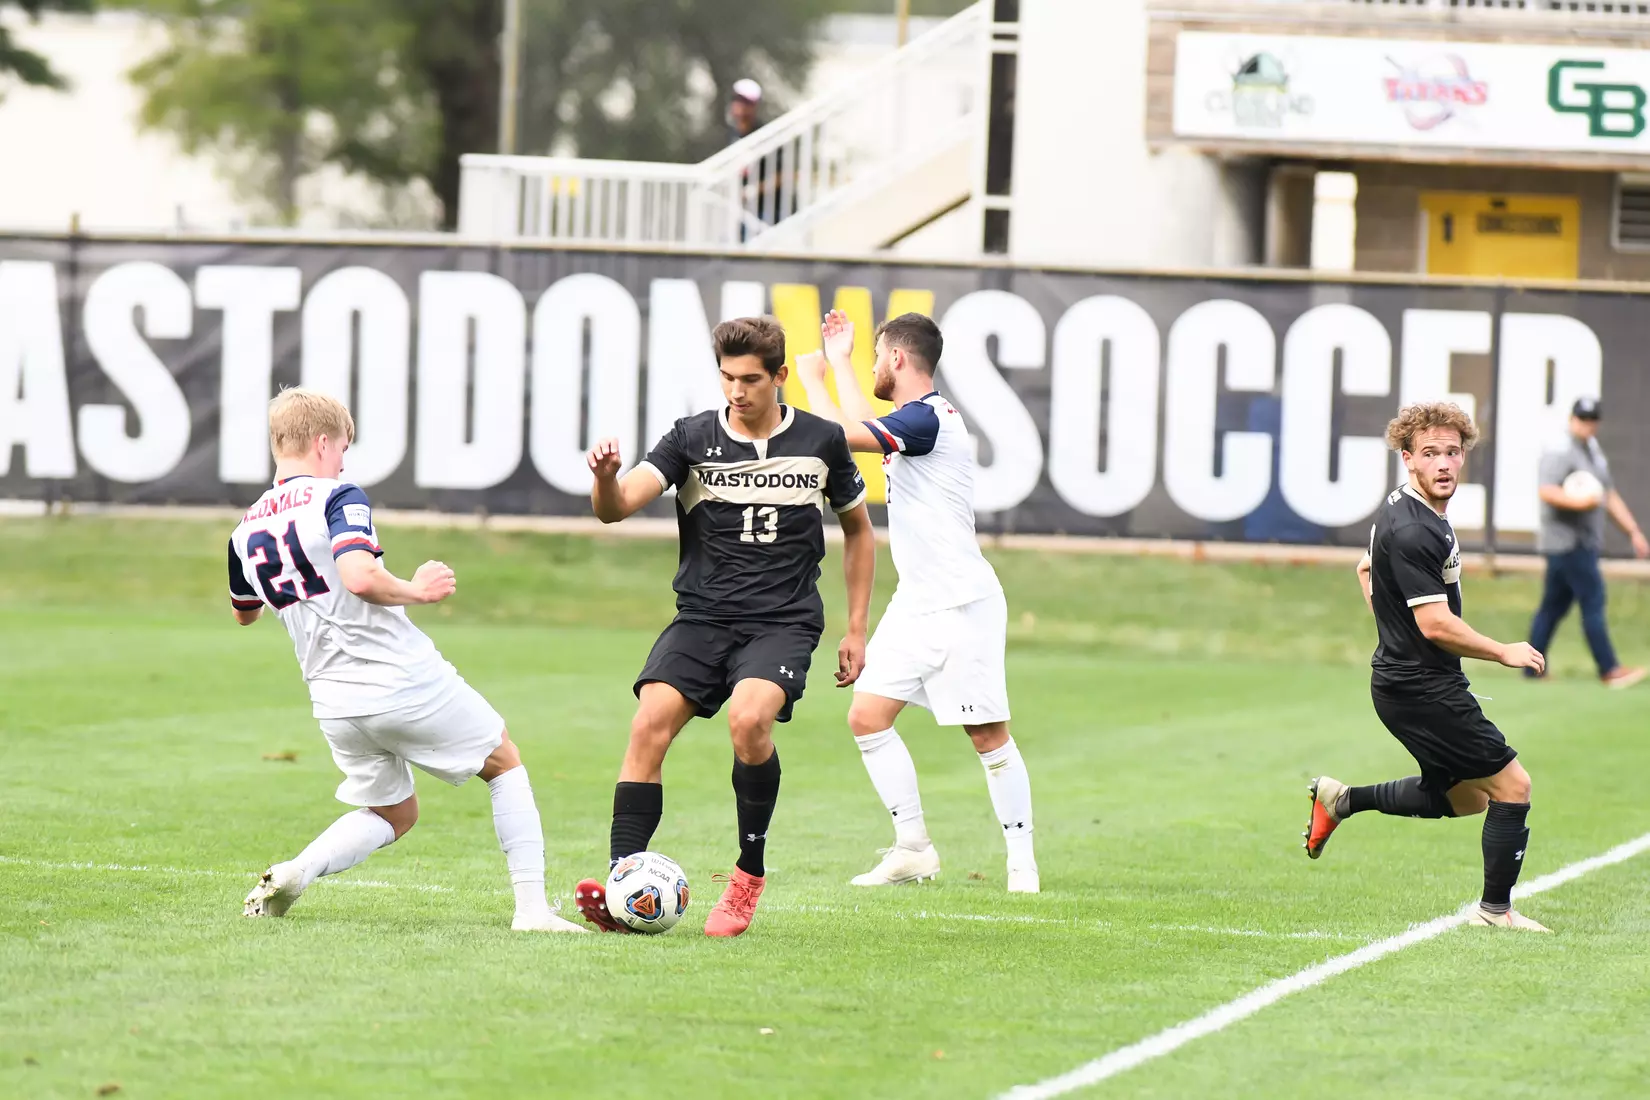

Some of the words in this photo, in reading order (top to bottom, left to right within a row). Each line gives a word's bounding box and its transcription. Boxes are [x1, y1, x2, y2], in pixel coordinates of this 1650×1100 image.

[1548, 60, 1647, 138] GB
[939, 290, 1603, 531] SOCCER
[698, 470, 819, 489] MASTODONS
[739, 506, 779, 543] 13
[247, 520, 330, 610] 21
[648, 868, 671, 883] NCAA
